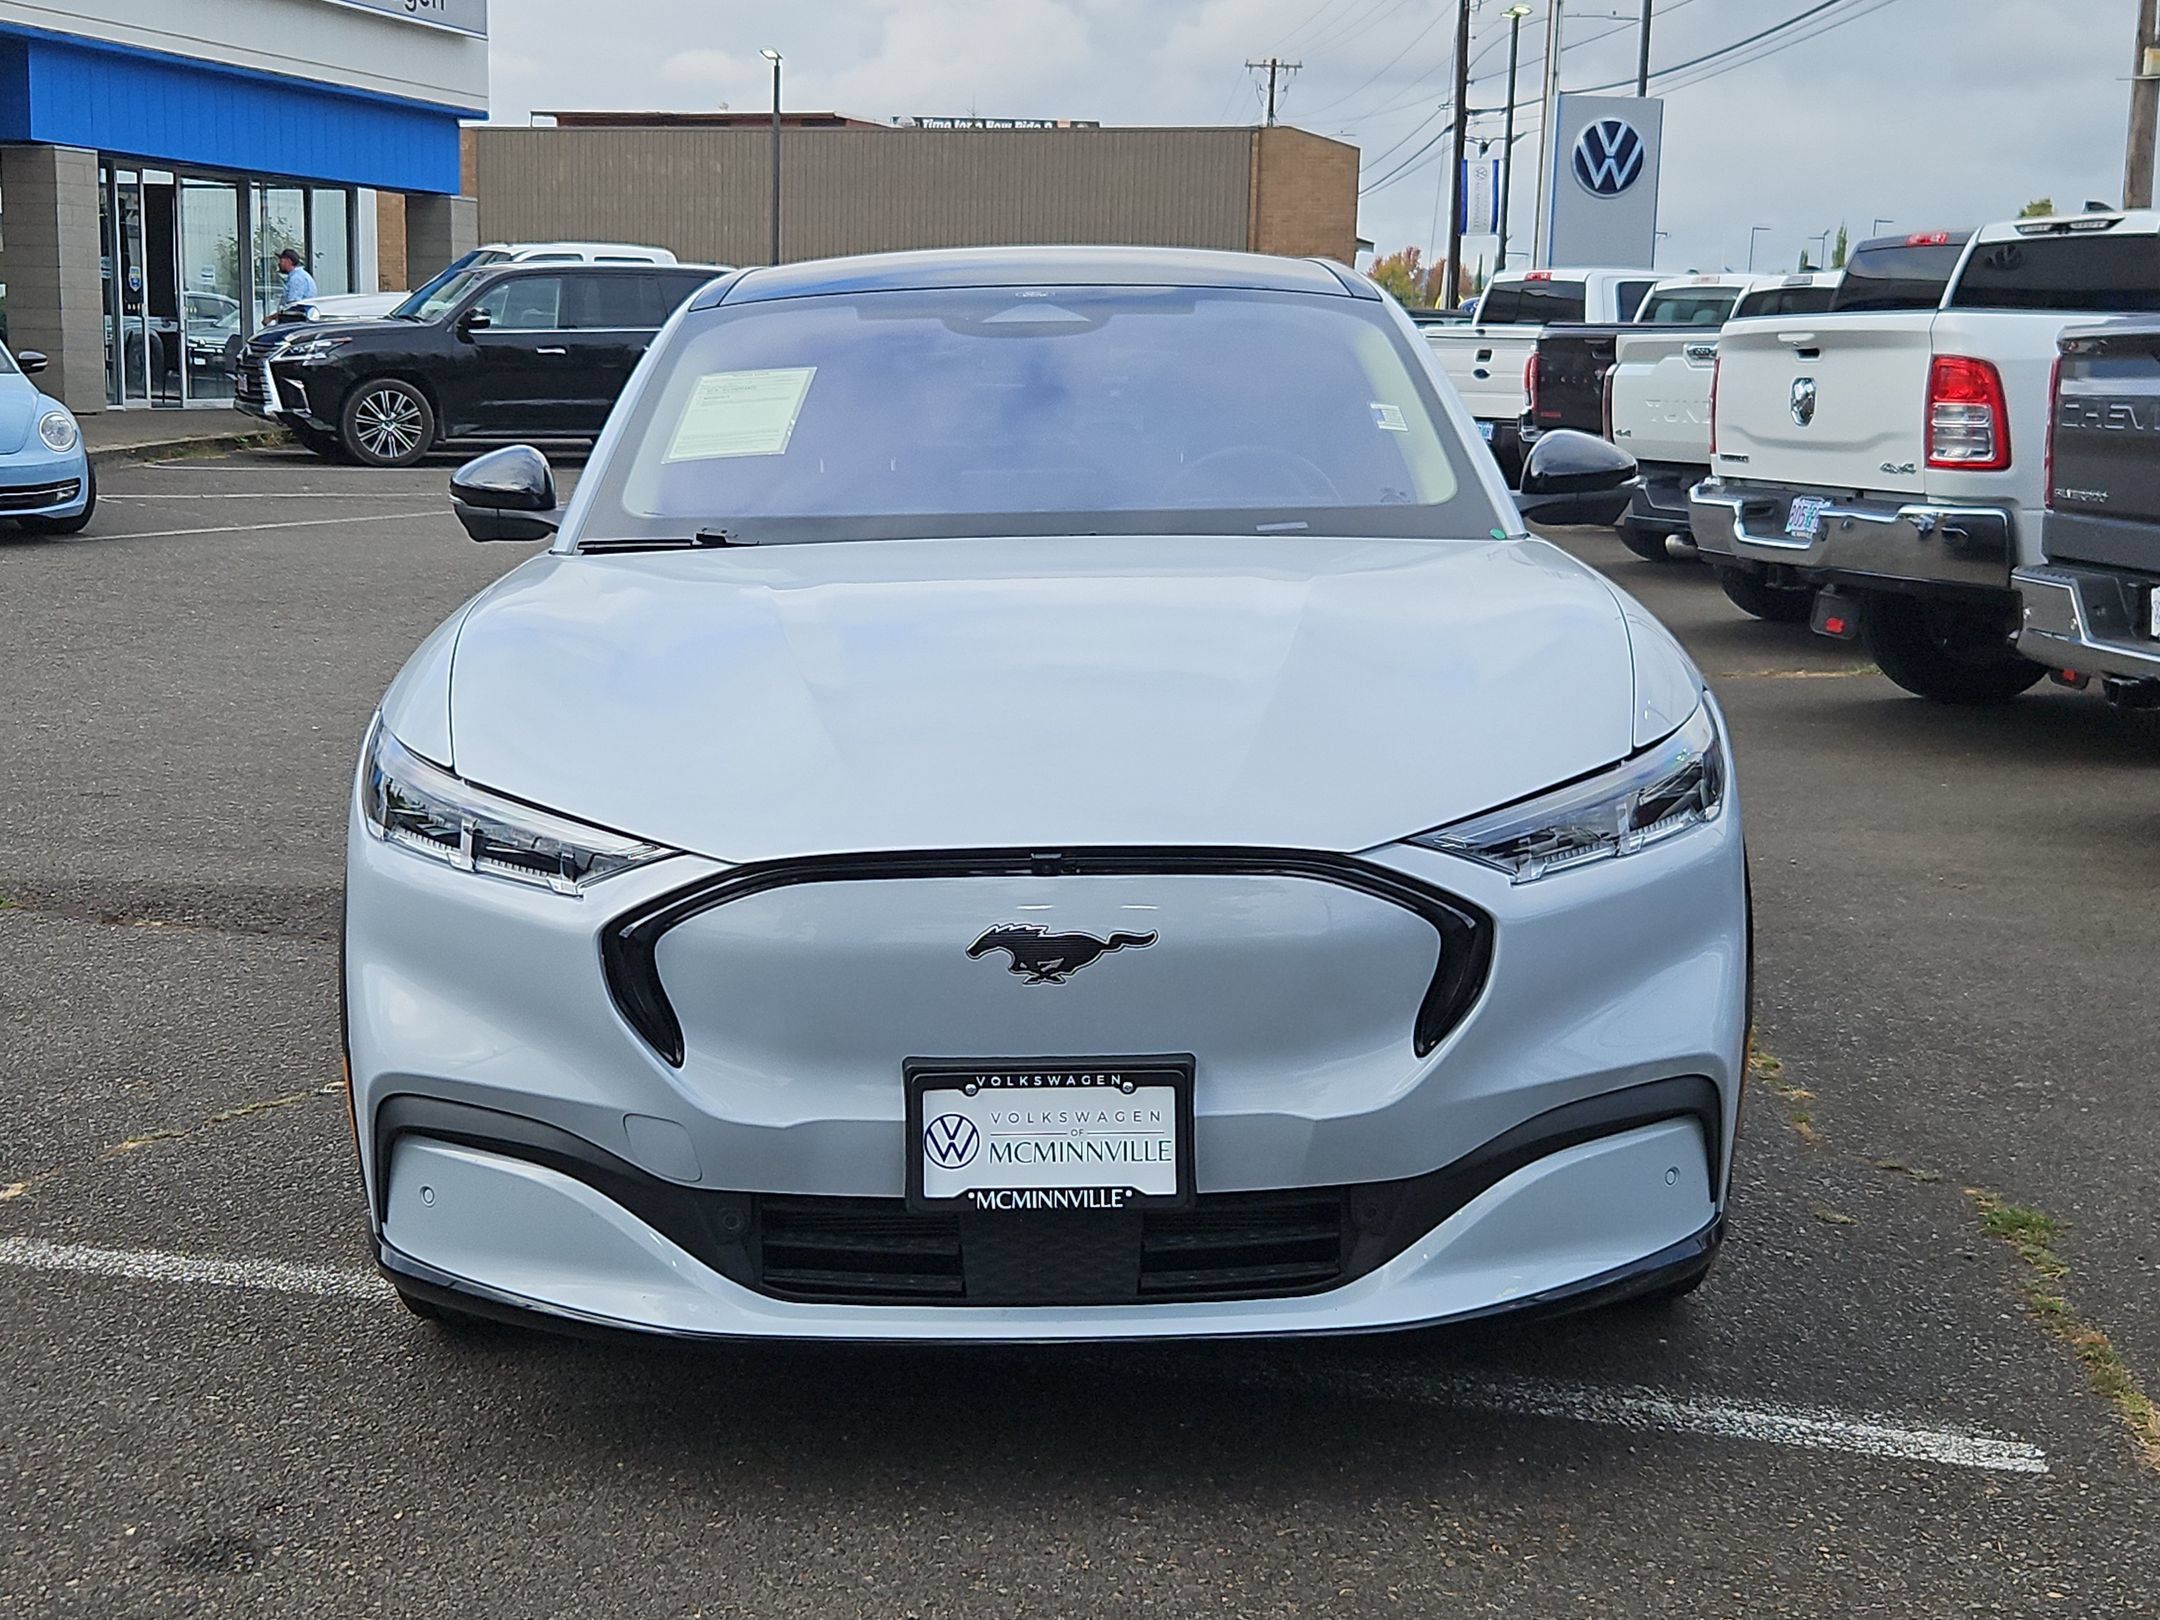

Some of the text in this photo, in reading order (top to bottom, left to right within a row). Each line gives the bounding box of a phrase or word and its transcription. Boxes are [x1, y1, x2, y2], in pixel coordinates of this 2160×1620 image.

[1573, 118, 1645, 197] VW
[975, 1074, 1122, 1088] VOLKSWAGEN
[990, 1110, 1162, 1125] VOLKSWAGEN
[924, 1114, 979, 1169] VW
[1070, 1128, 1084, 1137] OF
[989, 1140, 1173, 1164] MCMINNVILLE
[976, 1189, 1124, 1210] MCMINNVILLE
